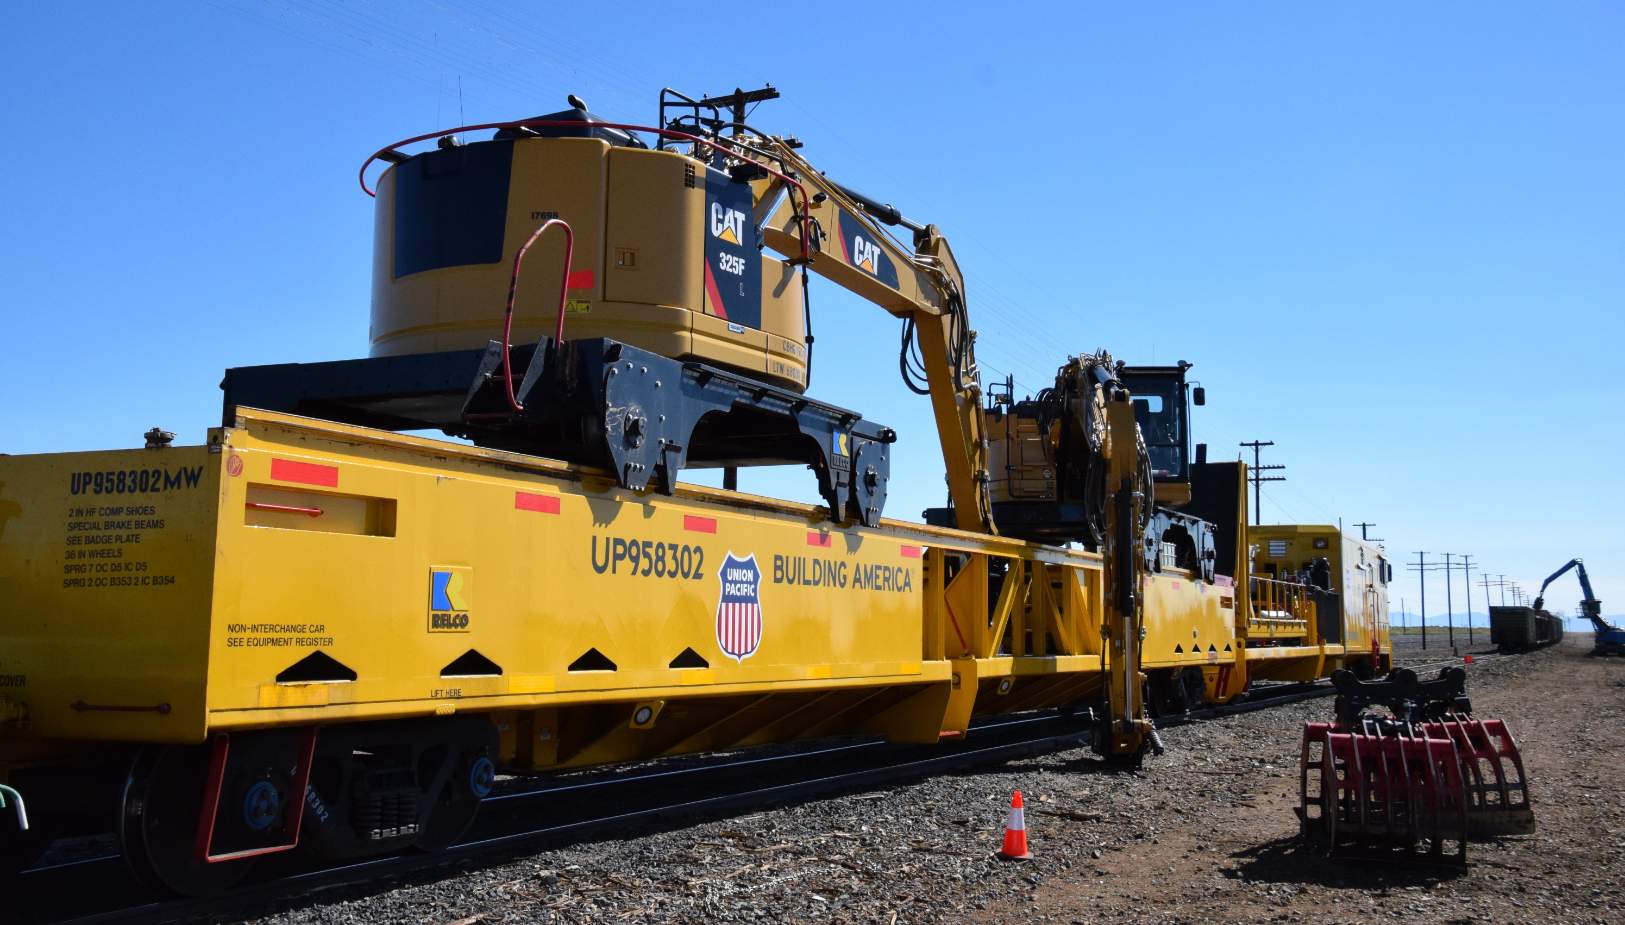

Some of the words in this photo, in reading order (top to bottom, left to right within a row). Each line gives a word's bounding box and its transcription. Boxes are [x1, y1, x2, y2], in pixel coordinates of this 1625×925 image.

[711, 201, 746, 247] CAT
[854, 235, 881, 276] CAT
[719, 252, 746, 276] 325F
[68, 508, 74, 518] 2
[75, 508, 84, 517] IN
[85, 507, 96, 517] HF
[99, 506, 124, 516] COMP
[125, 505, 157, 516] SHOES
[67, 521, 102, 531] SPECIAL
[104, 520, 132, 530] BRAKE
[135, 519, 165, 529] BEAMS
[66, 535, 82, 545] SEE
[84, 535, 113, 545] BADGE
[115, 534, 141, 544] PLATE
[77, 549, 86, 559] IN
[88, 548, 123, 558] WHEELS
[591, 535, 704, 580] UP958302
[63, 564, 87, 574] SPRG
[89, 563, 94, 573] 7
[726, 568, 754, 582] UNION
[773, 554, 847, 589] BUILDING
[852, 562, 913, 593] AMERICA
[63, 578, 86, 588] SPRG
[87, 577, 94, 587] 2
[134, 576, 139, 586] 2
[152, 575, 176, 585] B354
[725, 583, 755, 597] PACIFIC
[431, 613, 469, 629] RELCO
[227, 623, 307, 634] NON-INTERCHANGE
[308, 624, 325, 633] CAR
[227, 637, 244, 647] SEE
[246, 637, 294, 647] EQUIPMENT
[295, 637, 334, 647] REGISTER
[430, 689, 443, 698] LIFT
[445, 688, 462, 697] HERE
